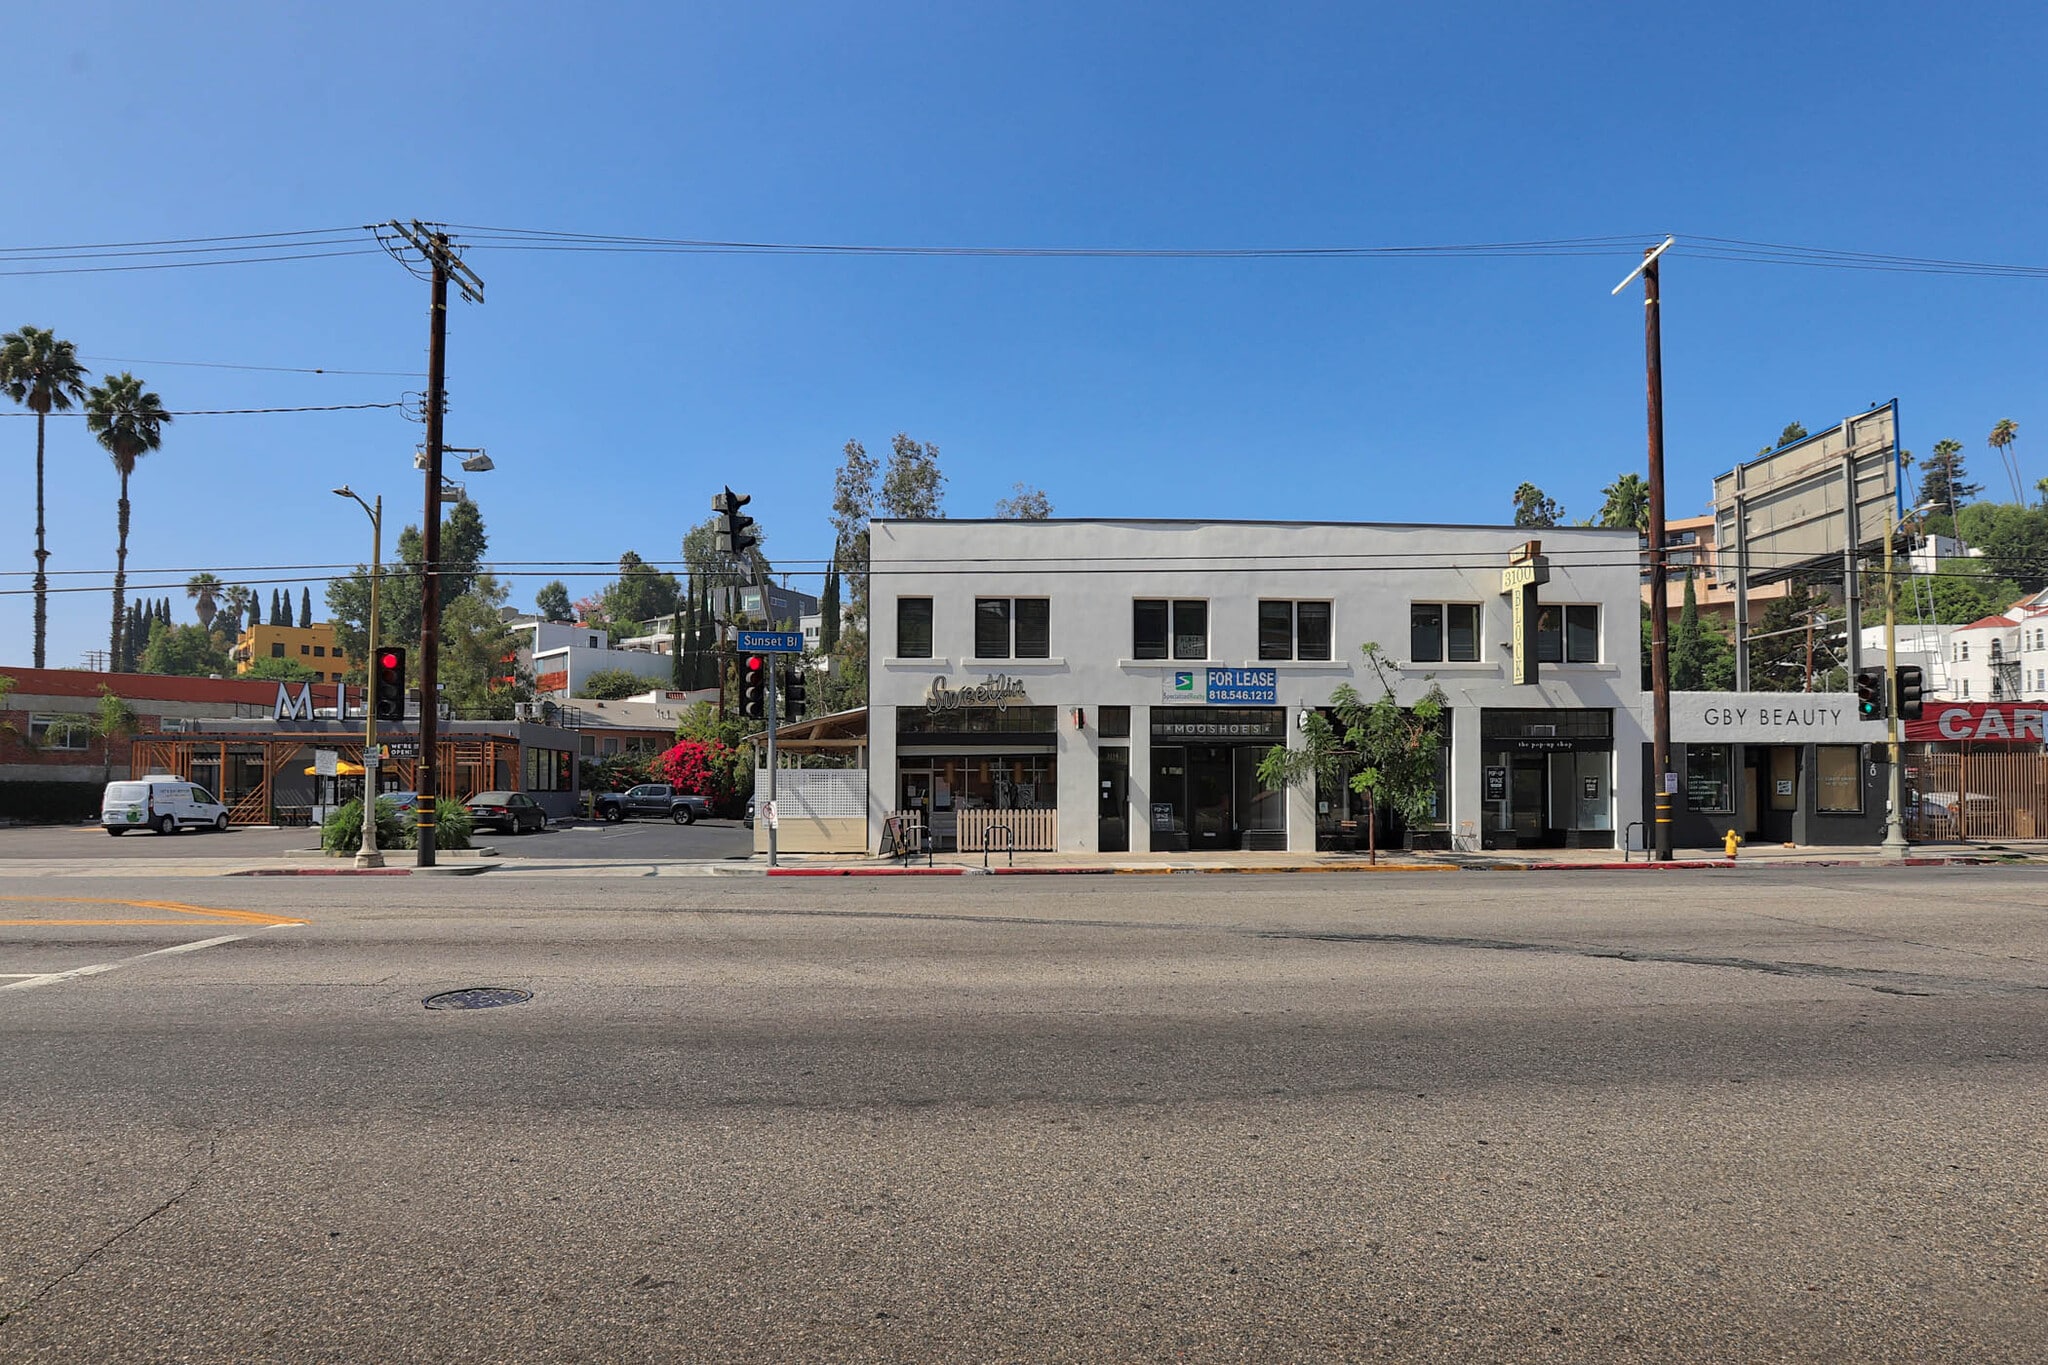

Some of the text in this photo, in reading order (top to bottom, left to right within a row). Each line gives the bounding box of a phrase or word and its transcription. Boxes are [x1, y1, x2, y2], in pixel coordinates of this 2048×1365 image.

[1504, 565, 1531, 587] 3100
[744, 635, 782, 647] Sunset
[1514, 591, 1522, 677] BLOCK
[1208, 671, 1275, 687] FOR LEASE
[926, 673, 1026, 713] Sweetfin
[1209, 690, 1274, 700] 818.546.1212
[1704, 708, 1842, 726] GBY BEAUTY
[1174, 724, 1259, 734] MOOSHOES
